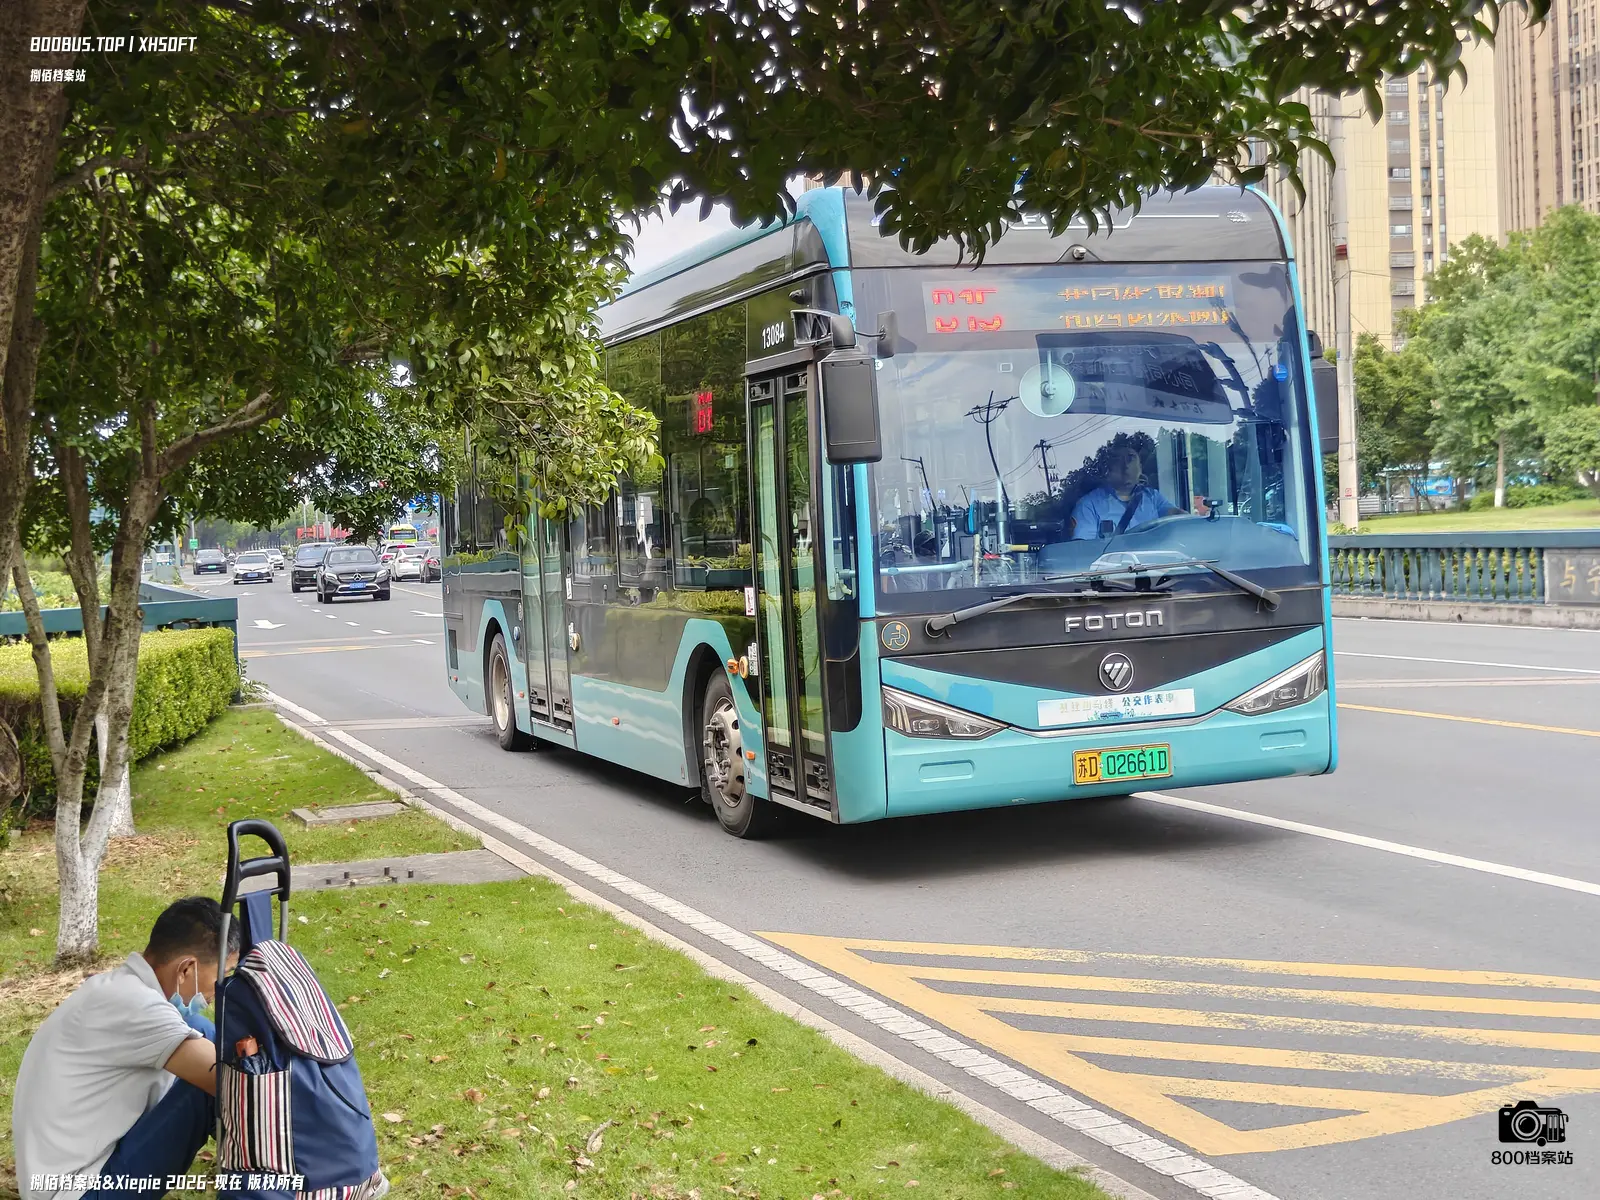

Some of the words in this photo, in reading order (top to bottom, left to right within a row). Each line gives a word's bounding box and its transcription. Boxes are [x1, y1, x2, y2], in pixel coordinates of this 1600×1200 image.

[762, 322, 785, 349] 13084
[1065, 610, 1164, 633] FOTON
[1106, 750, 1167, 776] 02661D
